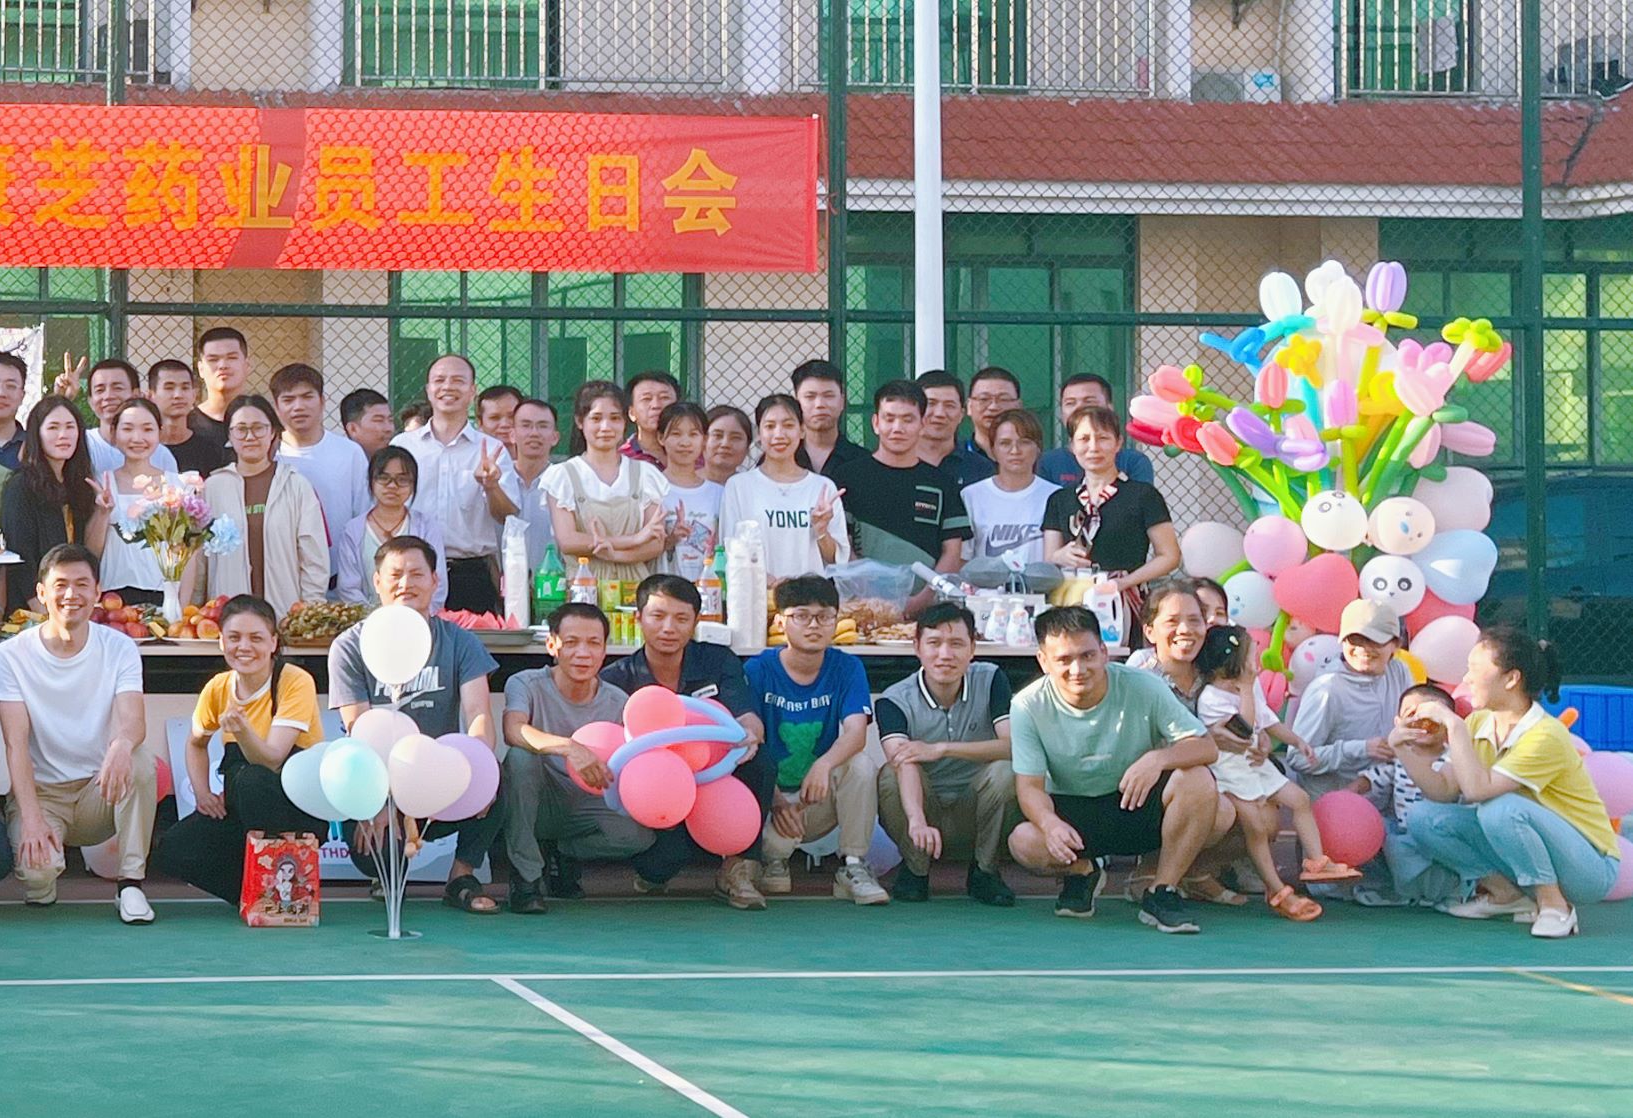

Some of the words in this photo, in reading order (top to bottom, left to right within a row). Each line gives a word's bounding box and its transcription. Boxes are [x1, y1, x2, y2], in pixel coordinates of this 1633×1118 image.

[764, 507, 814, 529] YONC
[990, 523, 1039, 542] NIKE
[319, 847, 350, 859] THD
